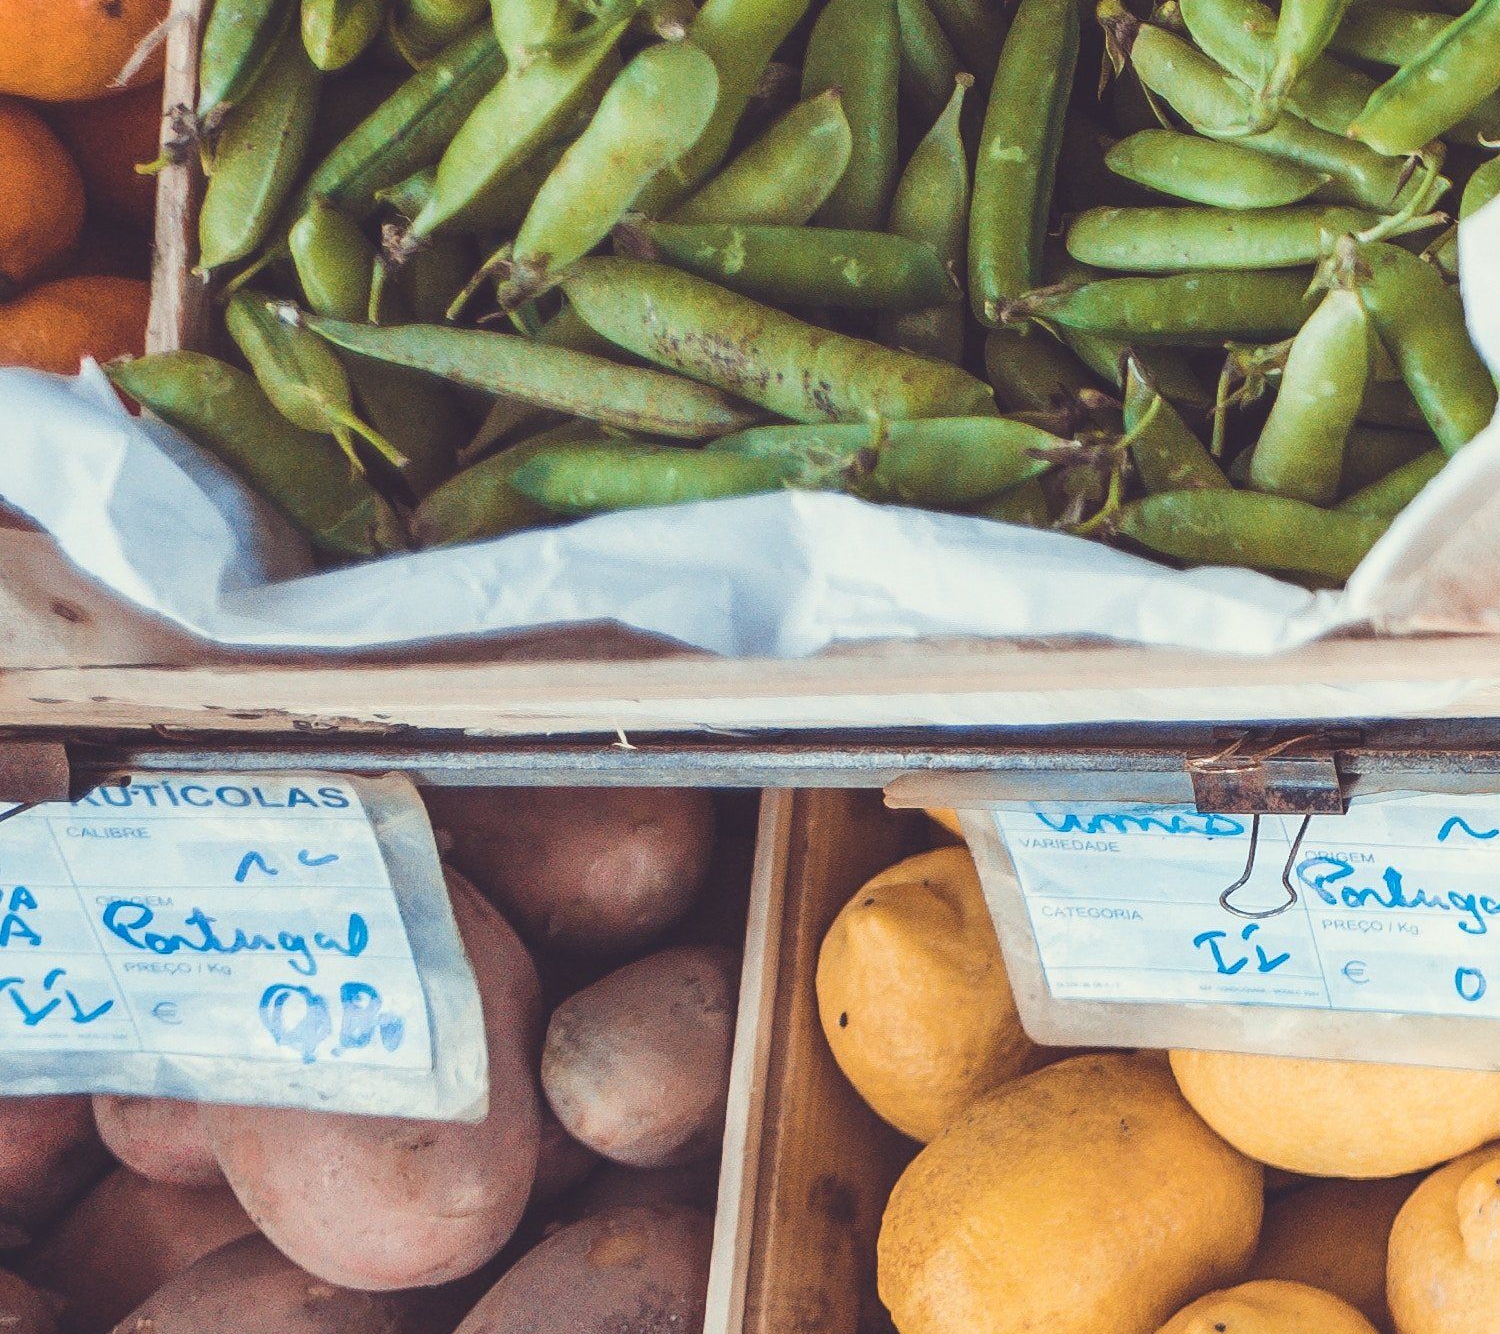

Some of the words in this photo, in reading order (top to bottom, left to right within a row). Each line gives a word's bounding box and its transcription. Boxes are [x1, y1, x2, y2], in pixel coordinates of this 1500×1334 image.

[66, 825, 151, 839] CALIBRE
[1018, 837, 1121, 853] VARIEDADE
[1305, 849, 1375, 864] ORIGEM
[1041, 905, 1143, 921] CATEGORIA
[1322, 919, 1383, 934] PREÇO
[1397, 921, 1420, 935] Kg
[103, 900, 368, 975] Portugal
[1342, 960, 1369, 984] €
[152, 1001, 183, 1025] €
